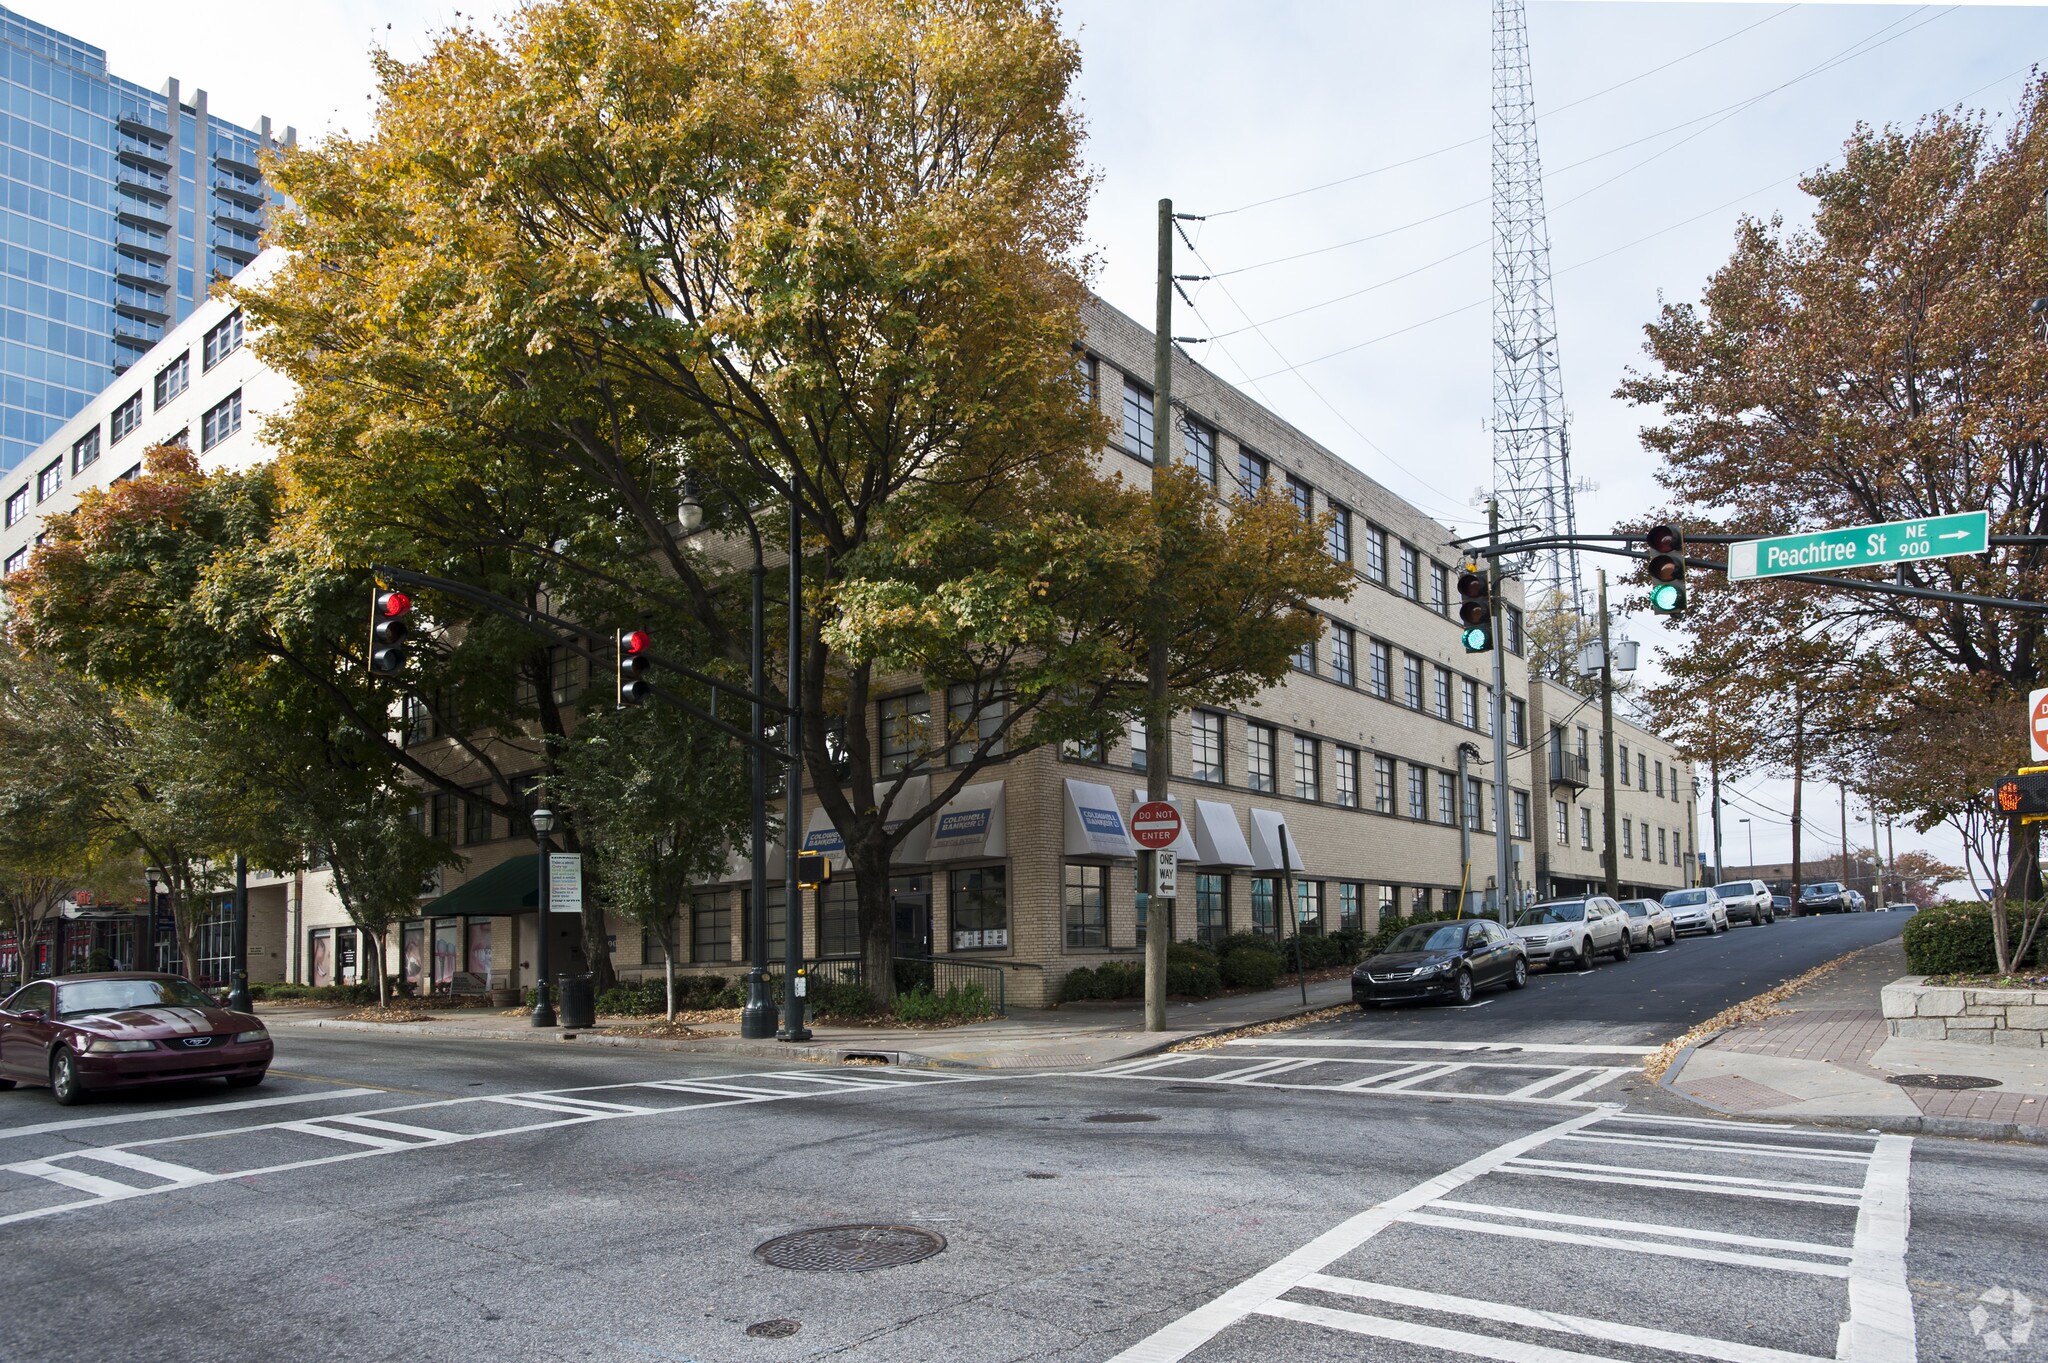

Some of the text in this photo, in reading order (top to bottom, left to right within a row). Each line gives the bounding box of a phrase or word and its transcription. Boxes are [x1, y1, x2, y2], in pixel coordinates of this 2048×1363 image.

[1905, 523, 1928, 539] NE
[1768, 533, 1887, 569] Peachtree St
[1898, 540, 1930, 557] 900
[1139, 810, 1173, 820] DO NOT
[1141, 831, 1171, 840] ENTER
[1159, 853, 1174, 865] ONE
[1159, 868, 1174, 880] WAY
